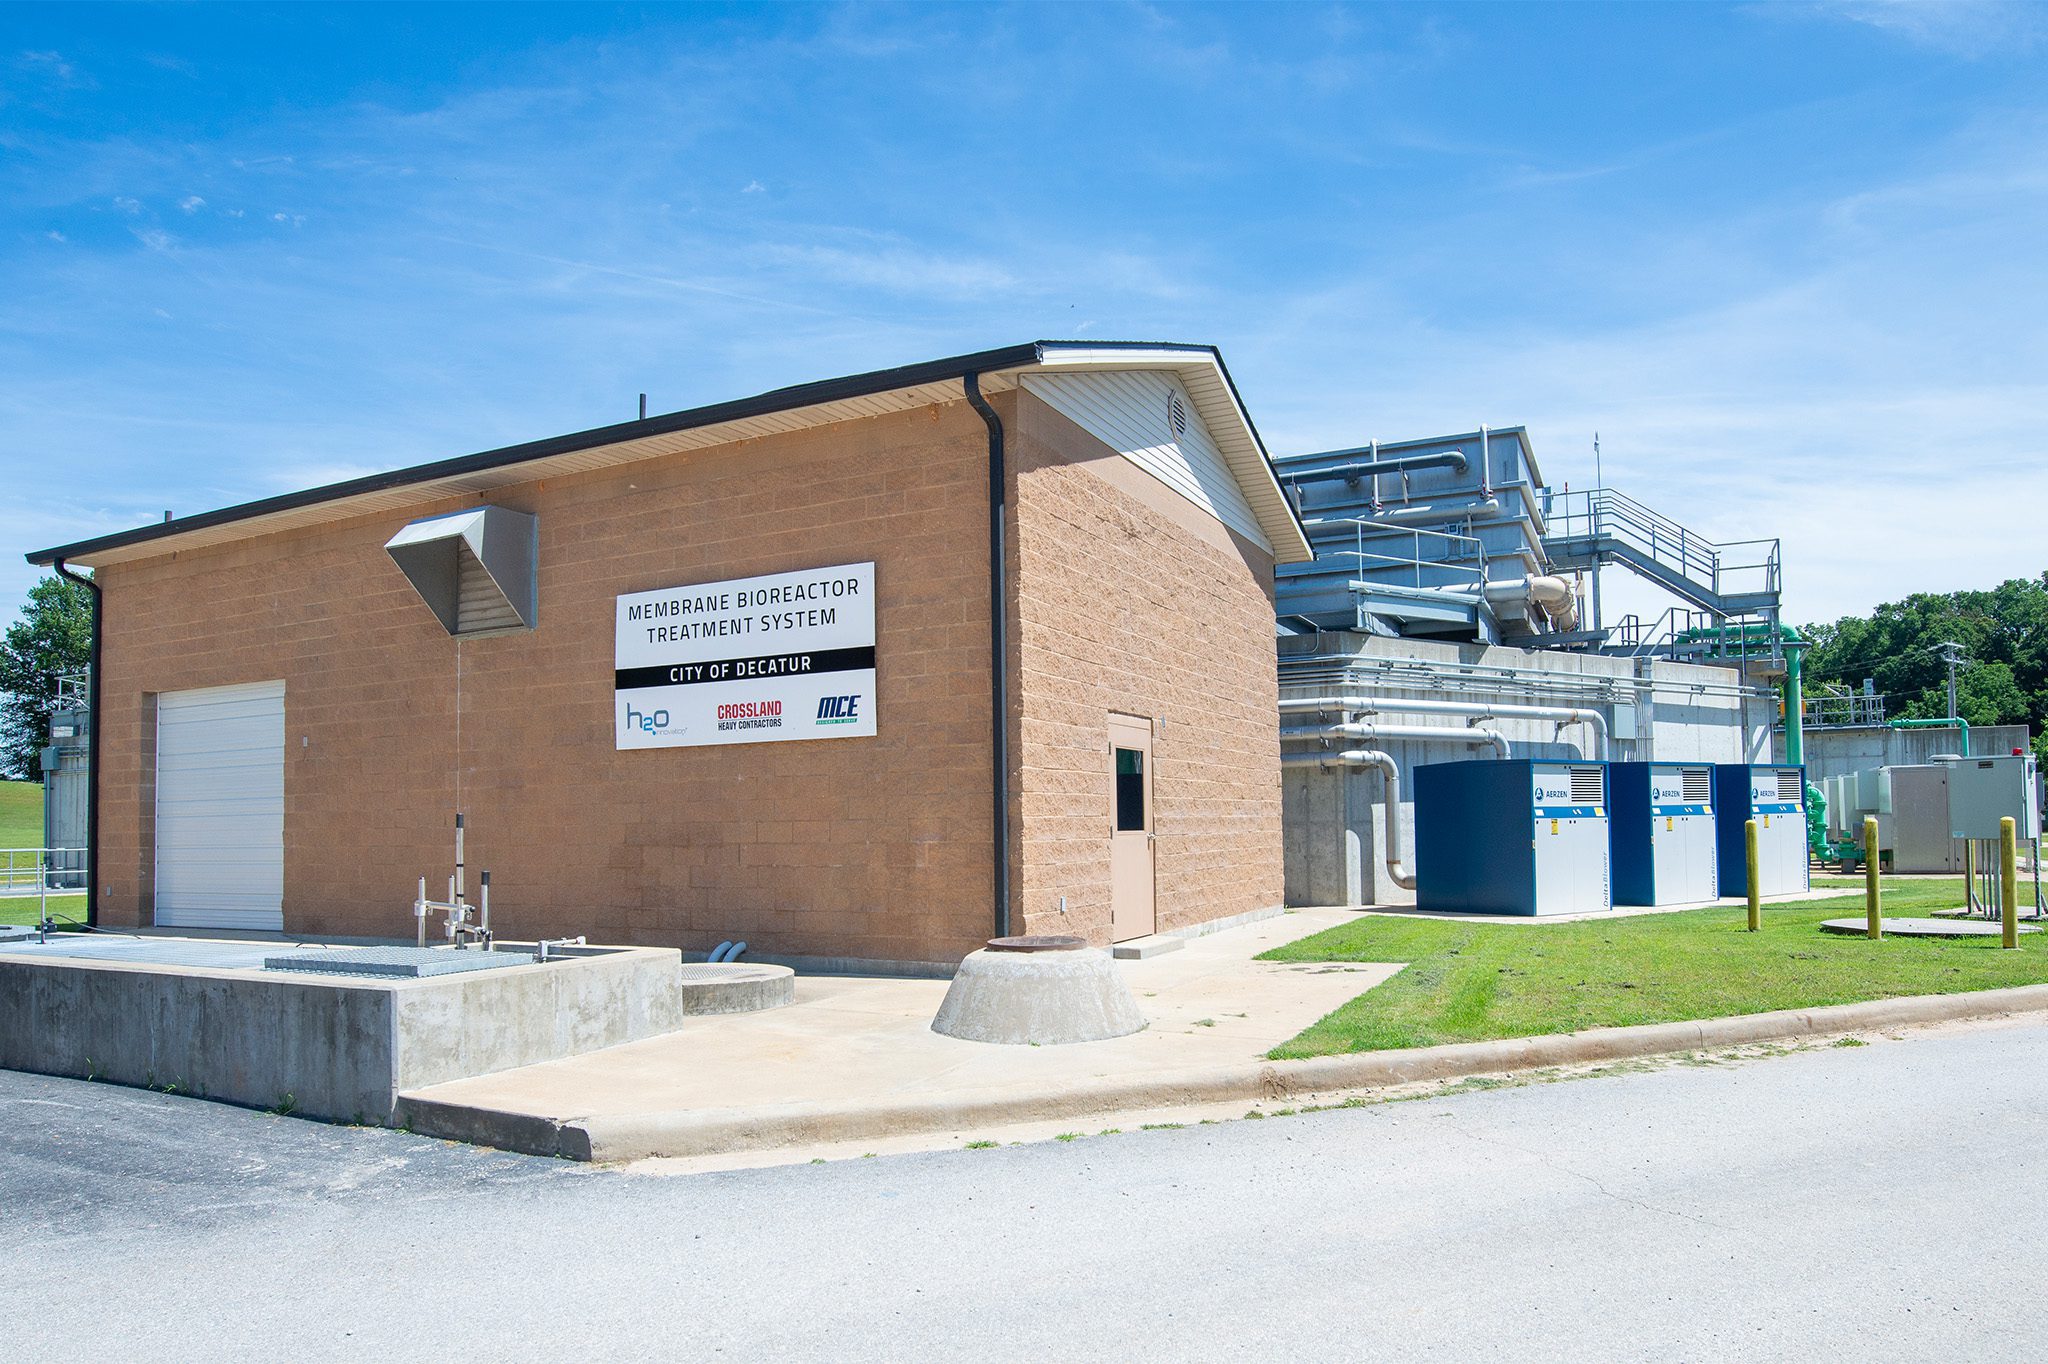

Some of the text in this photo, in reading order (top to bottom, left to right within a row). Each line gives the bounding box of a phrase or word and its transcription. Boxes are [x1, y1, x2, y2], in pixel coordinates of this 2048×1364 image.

[628, 578, 859, 621] MEMBRANE BIOREACTOR
[647, 608, 836, 643] TREATMENT SYSTEM
[669, 656, 811, 682] CITY OF DECATUR
[717, 700, 782, 719] CROSSLAND
[816, 695, 861, 719] MCE
[718, 718, 782, 731] HEAVY CONTRACTORS
[1546, 790, 1568, 798] AERZEN
